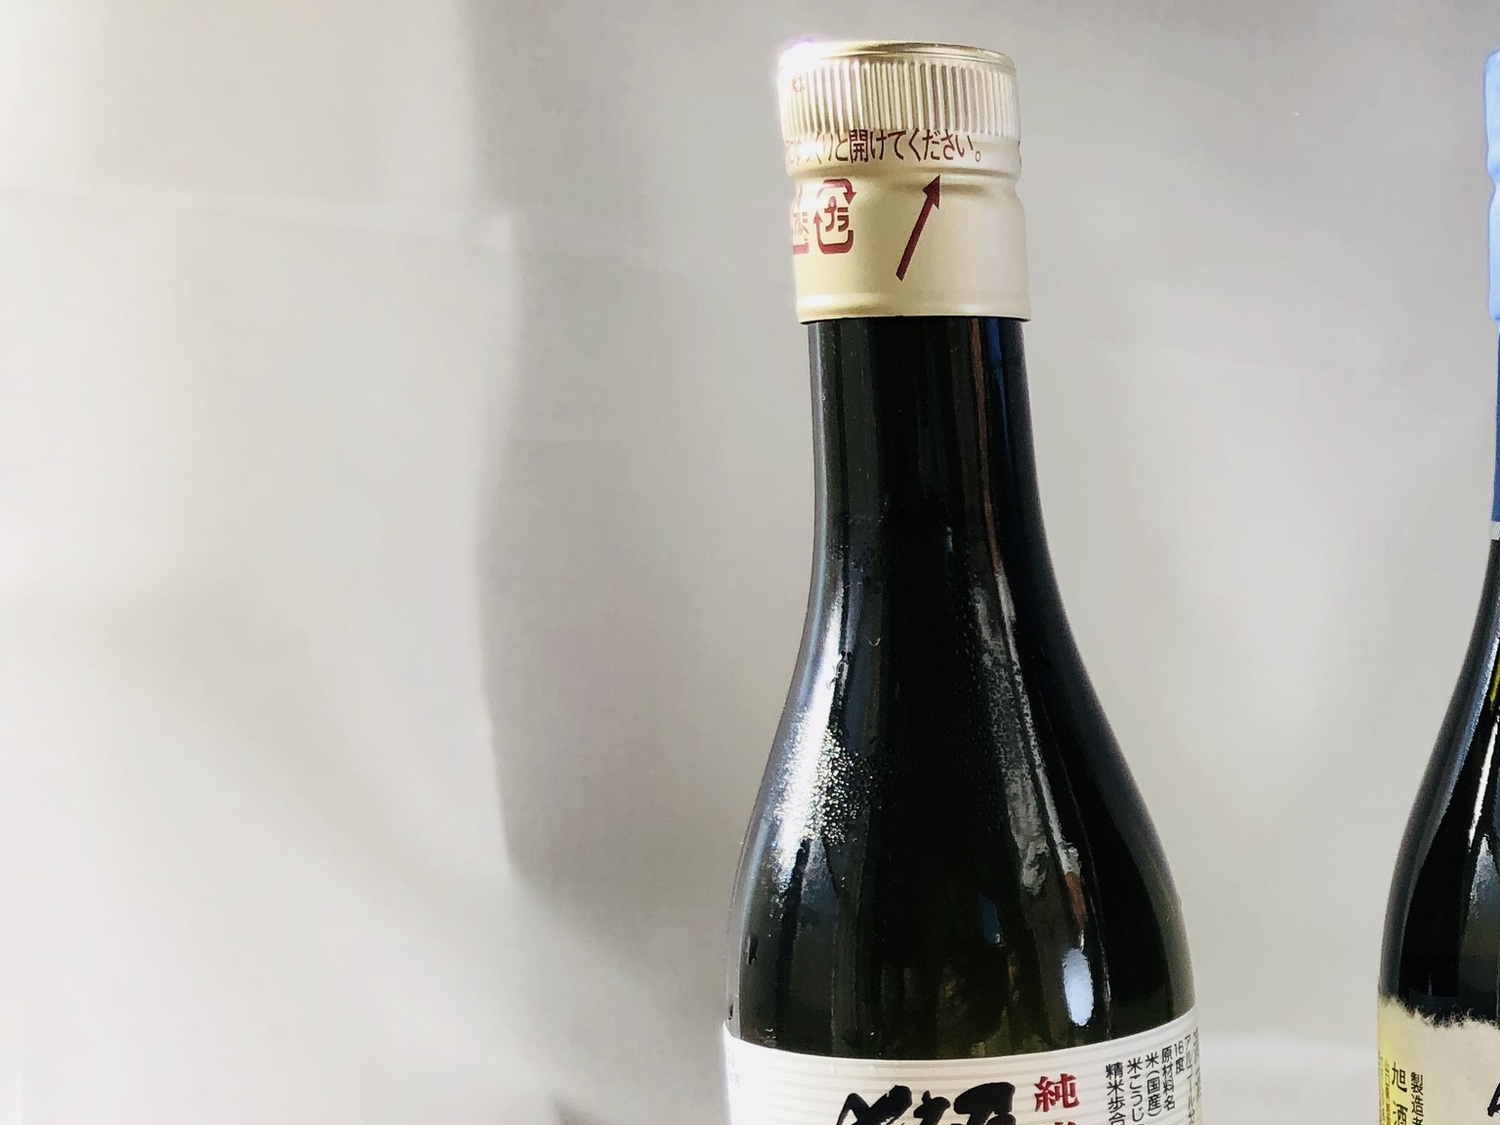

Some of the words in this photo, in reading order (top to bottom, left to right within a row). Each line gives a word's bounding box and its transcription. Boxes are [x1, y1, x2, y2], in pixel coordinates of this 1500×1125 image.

[824, 196, 849, 232] プラ
[1161, 1045, 1176, 1111] 原材料名
